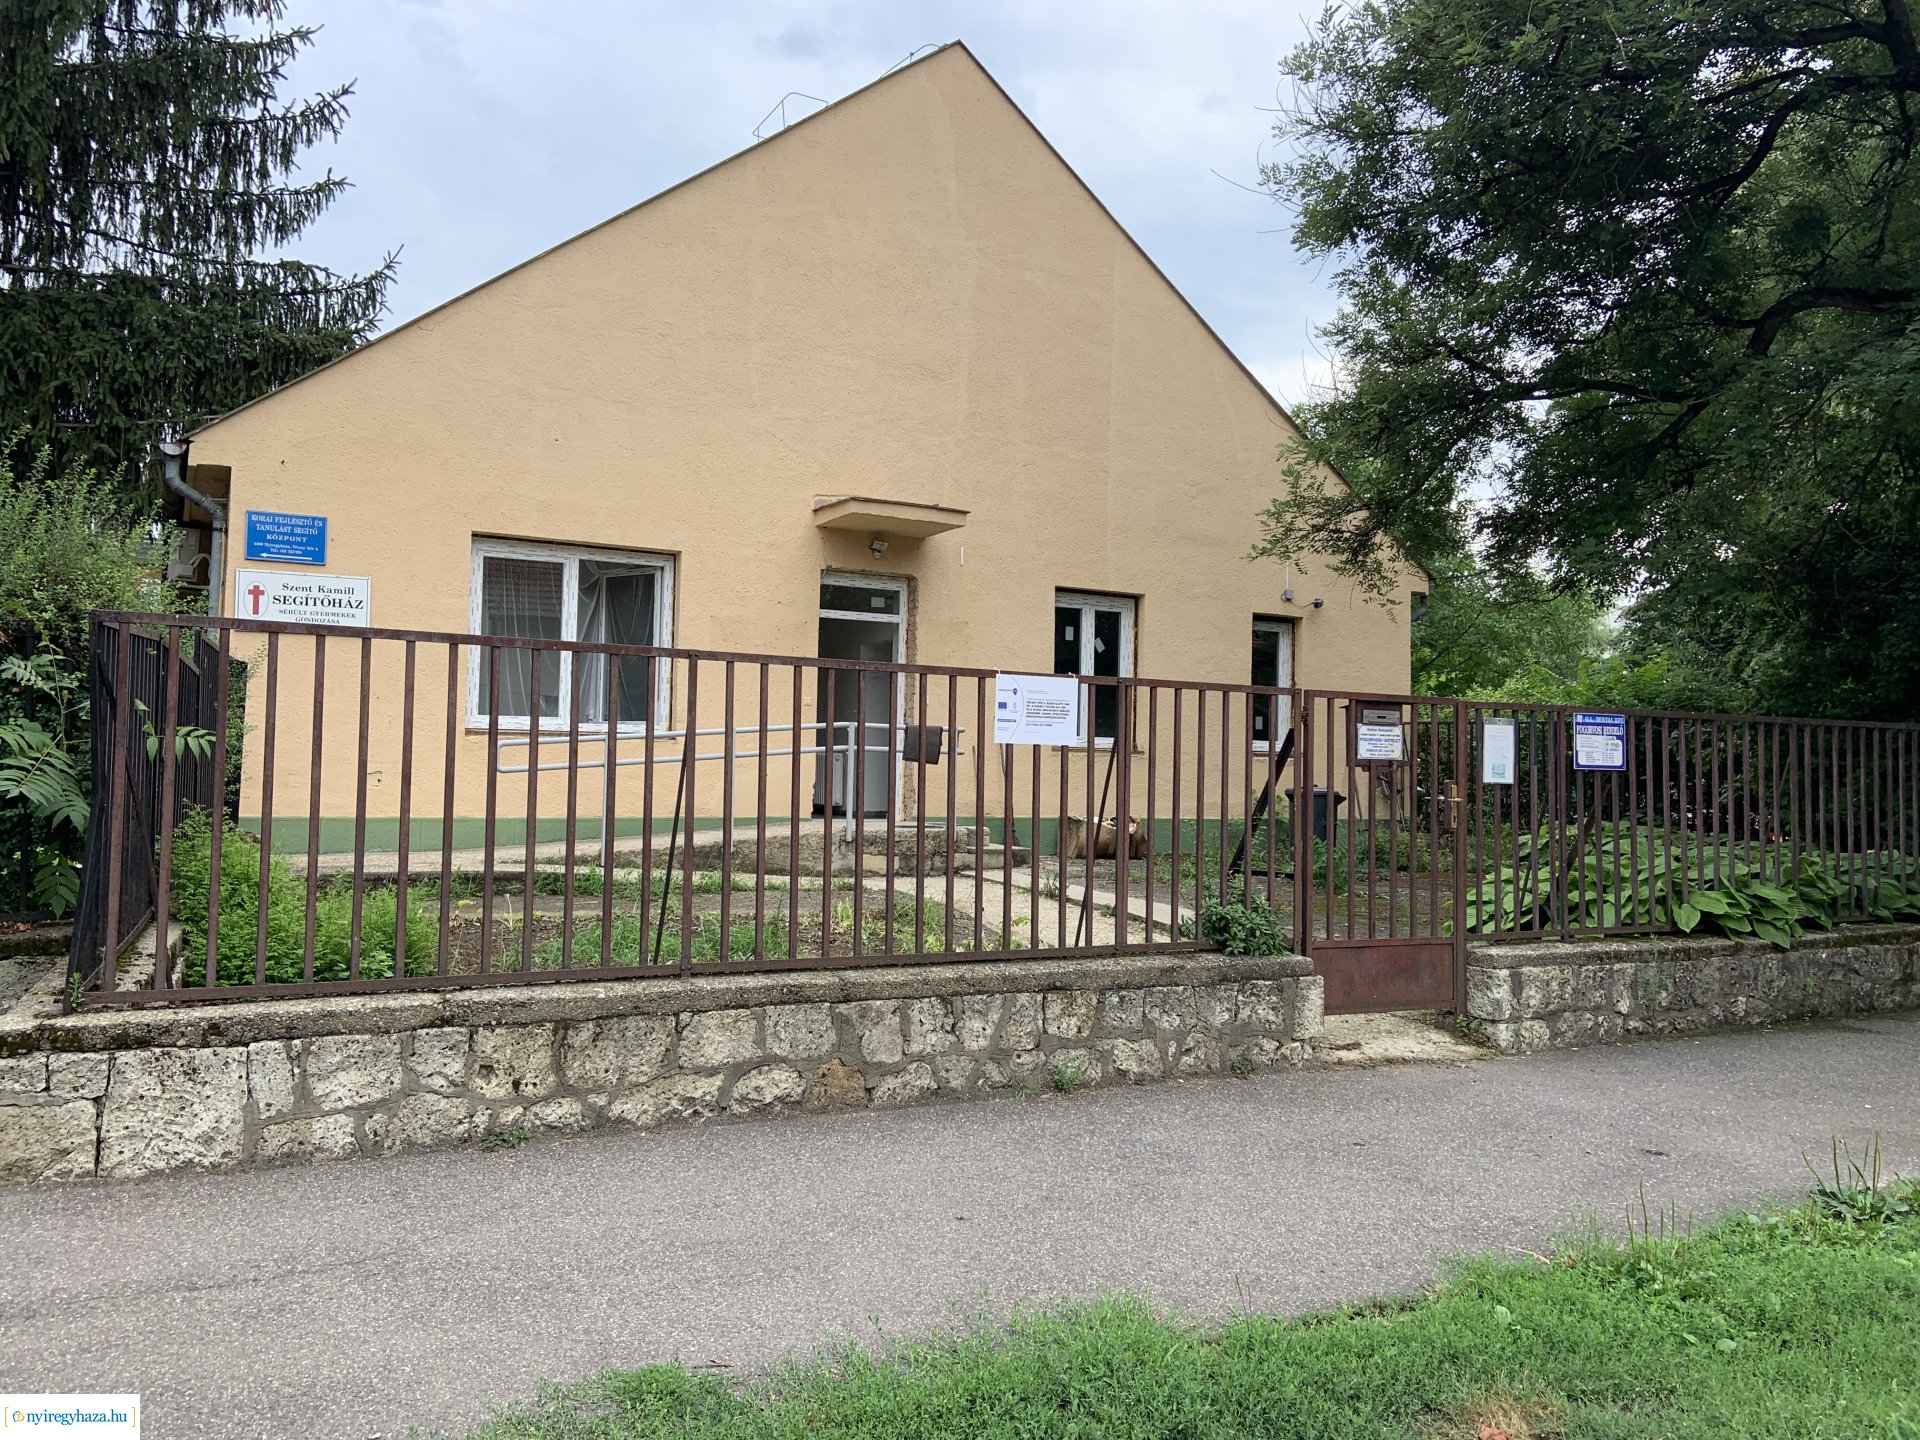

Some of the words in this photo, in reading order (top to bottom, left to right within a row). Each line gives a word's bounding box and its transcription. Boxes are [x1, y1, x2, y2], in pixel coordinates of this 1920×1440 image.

[252, 514, 273, 523] KORAI
[275, 516, 313, 526] FEJLESZTŐ
[314, 518, 323, 527] ÉS
[256, 523, 292, 533] TANULÁST
[293, 526, 318, 535] SEGÍTŐ
[266, 533, 307, 543] KÖZPONT
[281, 582, 313, 593] Szent
[317, 585, 355, 596] Kamill
[272, 593, 364, 610] SEGÍTŐHÁZ
[278, 608, 308, 616] SÉRÜLT
[309, 610, 357, 619] GYERMEKEK
[295, 616, 341, 625] GONDOZÁSA
